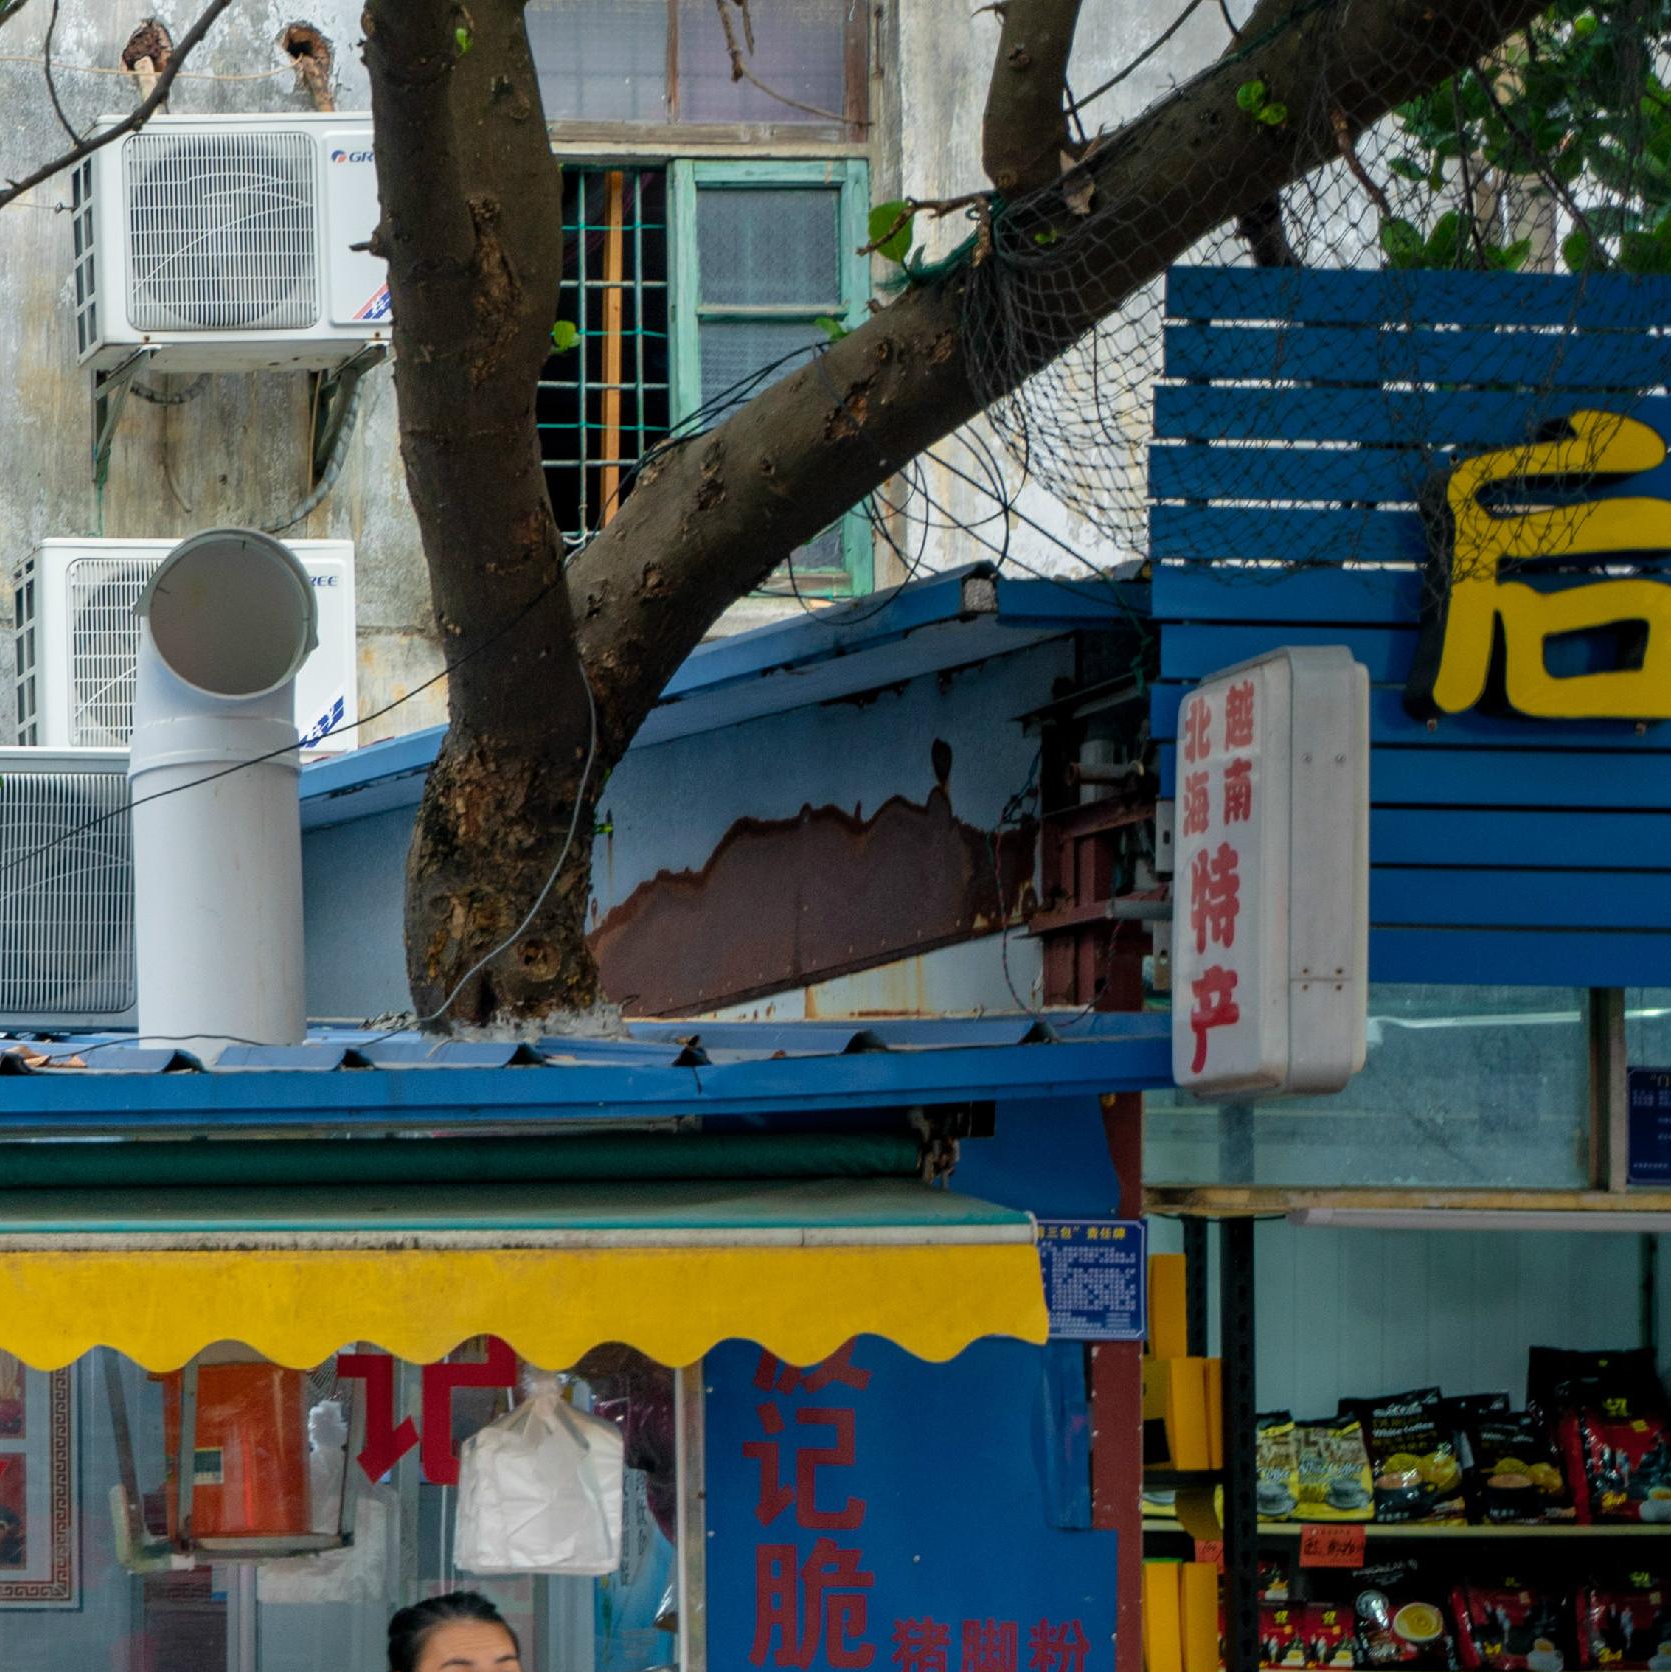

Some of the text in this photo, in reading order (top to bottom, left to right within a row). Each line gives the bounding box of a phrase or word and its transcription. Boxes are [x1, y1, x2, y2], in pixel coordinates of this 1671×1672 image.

[349, 151, 375, 163] GR
[309, 576, 338, 587] REE
[1182, 696, 1211, 837] 北海
[1223, 679, 1255, 826] 越南
[1190, 843, 1241, 1074] 特产
